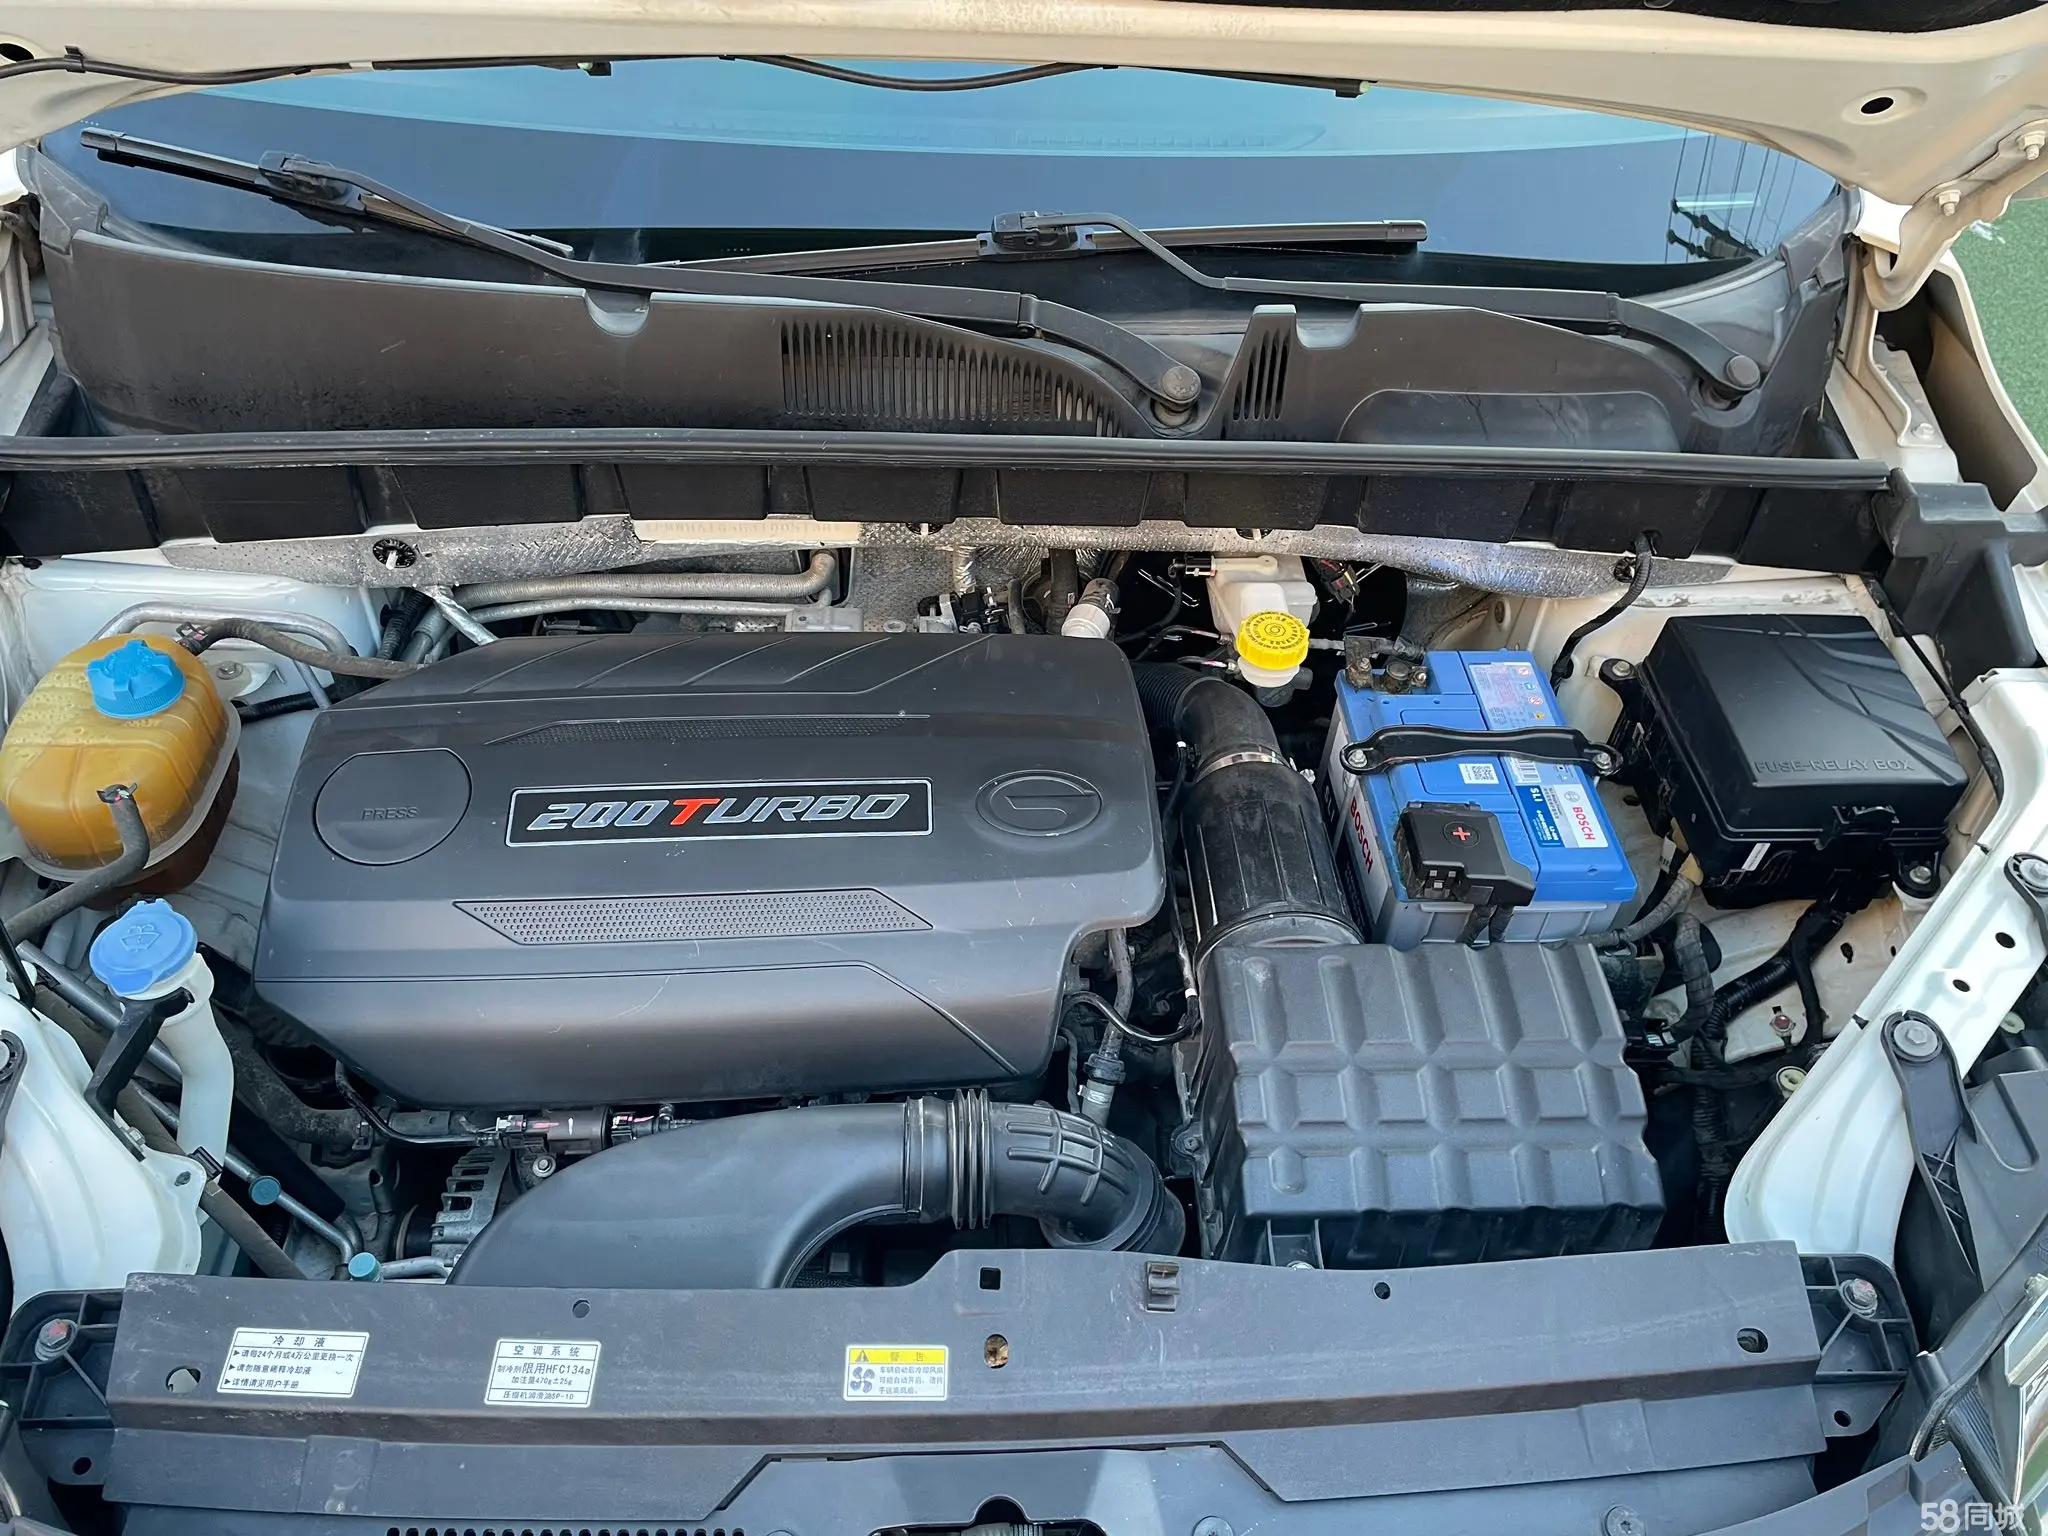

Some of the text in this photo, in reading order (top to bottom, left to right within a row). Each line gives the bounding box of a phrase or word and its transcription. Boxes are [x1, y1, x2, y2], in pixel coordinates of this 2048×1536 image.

[1753, 759, 1915, 773] FUSE-RELAY BOX
[1530, 787, 1544, 802] SLI
[361, 806, 419, 820] PRESS
[1572, 806, 1596, 840] BOSCH
[1350, 796, 1374, 875] BOSCH
[272, 1335, 327, 1348] 冷却液
[513, 1345, 581, 1357] 空调系统
